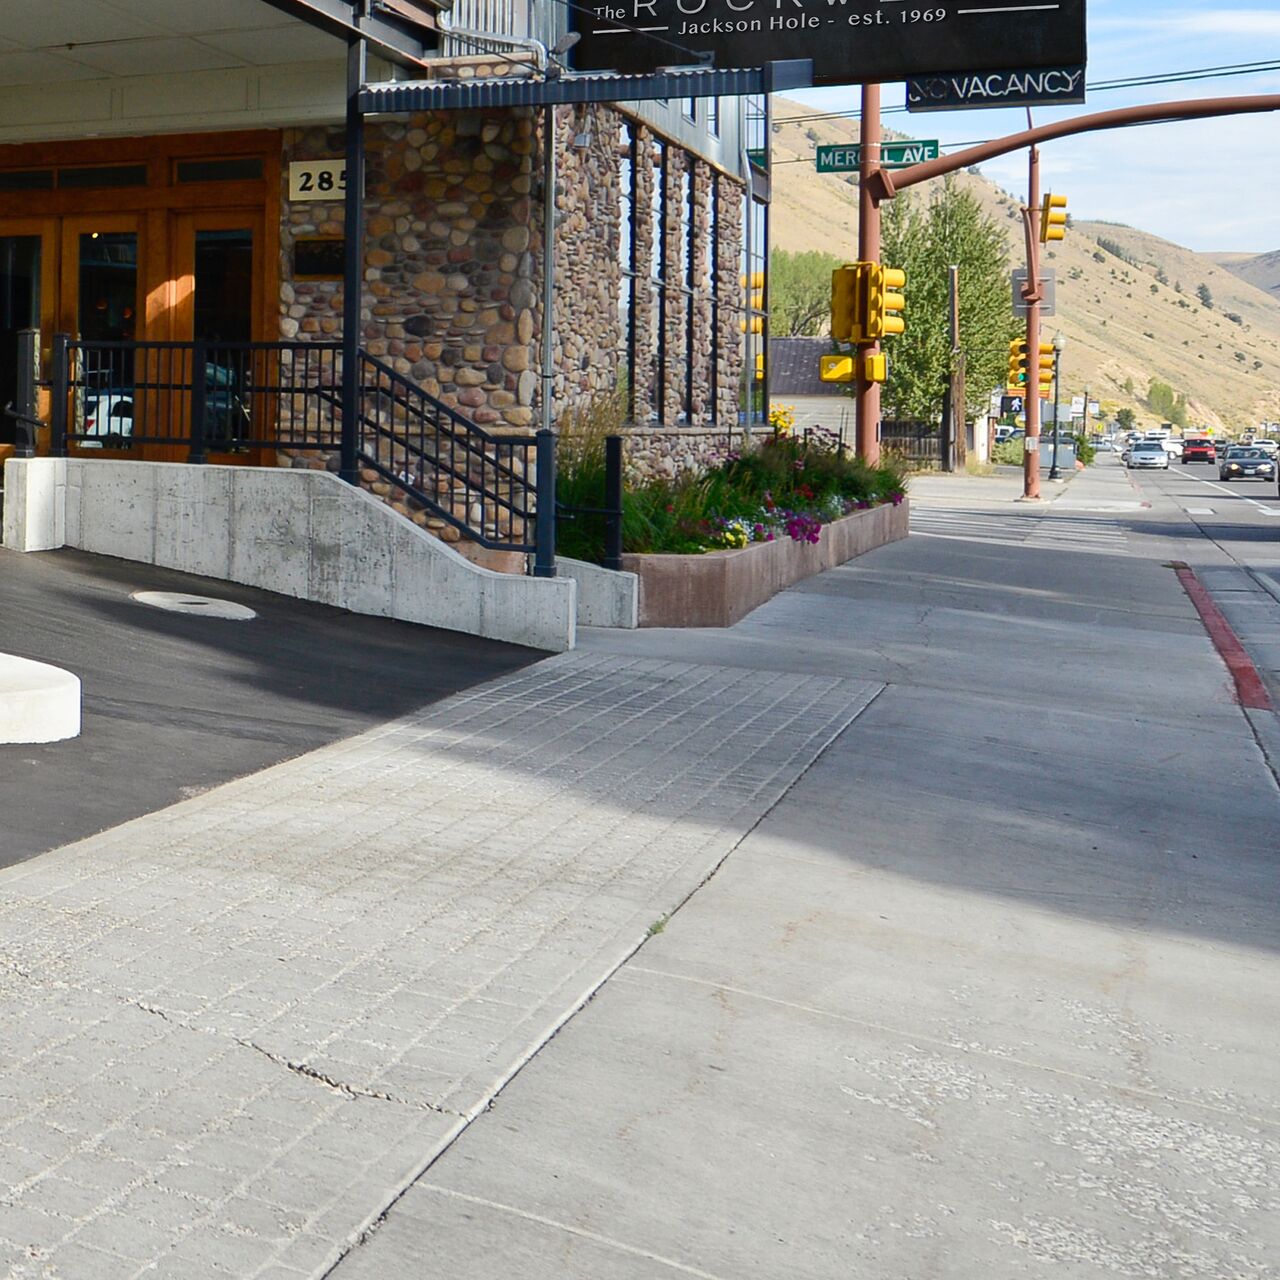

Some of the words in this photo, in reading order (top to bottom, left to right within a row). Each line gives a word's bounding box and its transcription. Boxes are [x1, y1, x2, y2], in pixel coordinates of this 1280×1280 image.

[593, 5, 626, 20] The
[678, 17, 761, 36] Jackson
[769, 12, 820, 30] Hole
[848, 8, 890, 25] est.
[899, 7, 947, 24] 1969
[952, 70, 1082, 99] VACANCY
[821, 148, 895, 166] MERL
[902, 146, 934, 163] AVE
